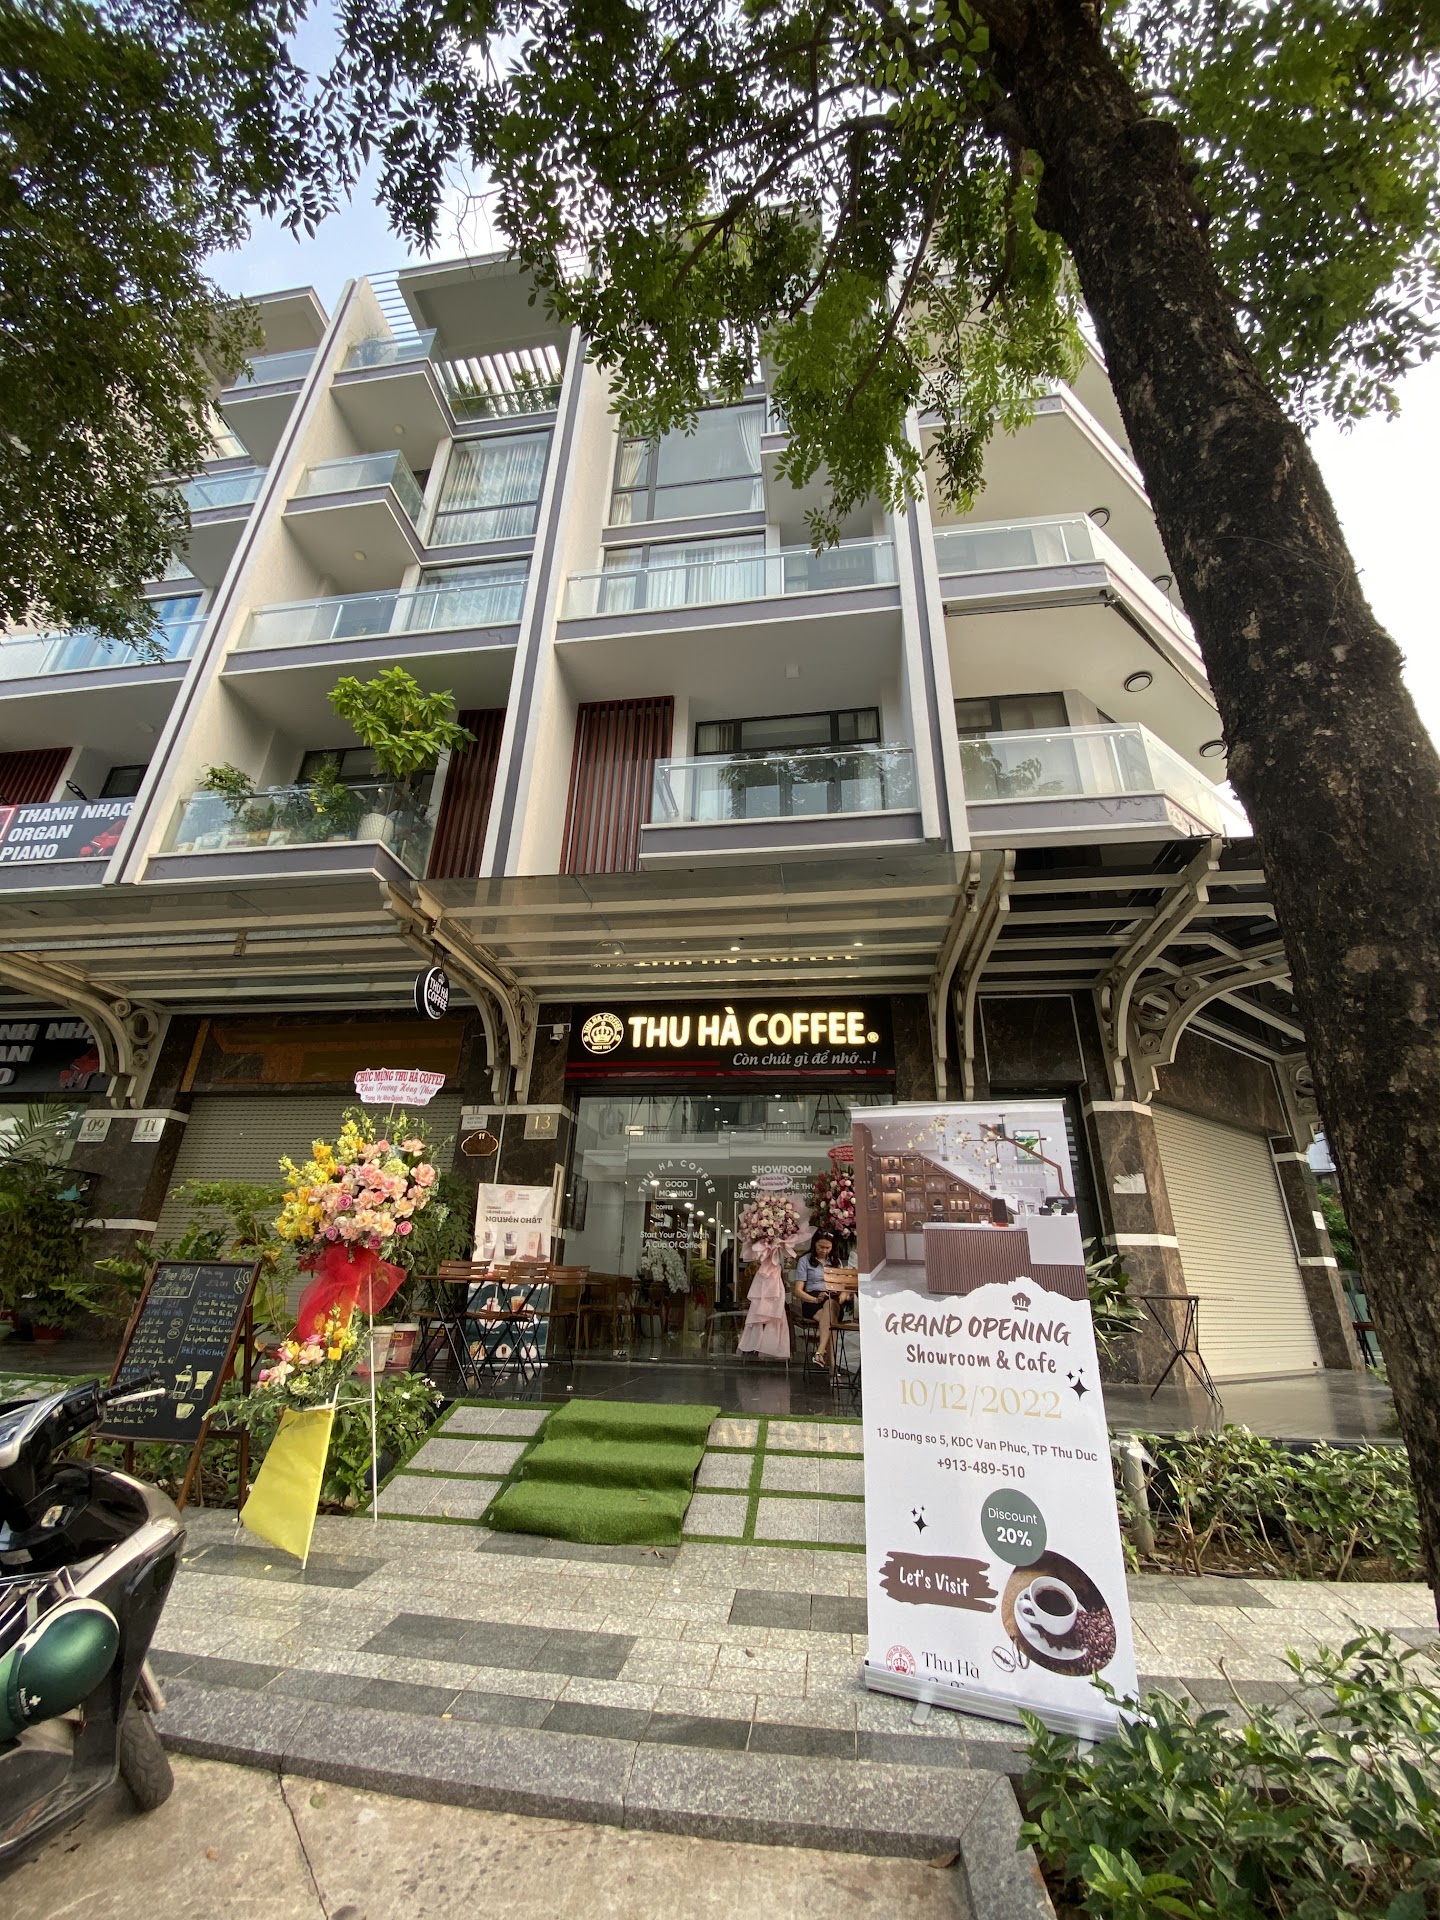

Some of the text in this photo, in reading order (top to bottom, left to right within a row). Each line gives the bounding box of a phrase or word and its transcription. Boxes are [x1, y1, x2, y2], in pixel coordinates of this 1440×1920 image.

[17, 802, 134, 823] THANH NHẠC
[8, 824, 73, 842] ORGAN
[0, 844, 58, 861] PIANO
[429, 977, 441, 994] THU
[428, 989, 447, 1011] COFFEE
[603, 1014, 622, 1031] COFFEE
[628, 1015, 691, 1048] THU
[697, 1006, 742, 1047] HÀ
[733, 1053, 759, 1066] Còn
[762, 1051, 792, 1066] chút
[794, 1052, 809, 1069] gì
[811, 1049, 831, 1065] để
[356, 1069, 374, 1083] CHÚC
[395, 1070, 408, 1082] THU
[420, 1073, 444, 1086] COFFEE
[87, 1119, 105, 1132] 09
[143, 1119, 157, 1132] 11
[534, 1115, 552, 1130] 13
[637, 1160, 716, 1194] THU HA COFFEE
[751, 1165, 812, 1174] SHOWROOM
[640, 1231, 657, 1239] Start
[658, 1231, 675, 1239] Your
[676, 1231, 691, 1240] Day
[652, 1241, 667, 1250] Cup
[669, 1241, 678, 1249] Of
[679, 1241, 702, 1249] Coffee
[885, 1312, 1072, 1347] GRAND OPENING
[906, 1344, 1058, 1375] Showroom & Cafe
[899, 1378, 1063, 1420] 10/12/2022
[877, 1427, 1099, 1463] 13 Duong so 5, KDC Van Phuc, TP Thu Duc
[937, 1458, 1026, 1479] +913-489-510
[988, 1507, 1038, 1526] Discount
[996, 1526, 1033, 1548] 20%
[899, 1566, 970, 1597] Let's Visit
[921, 1651, 980, 1679] Thu Hà
